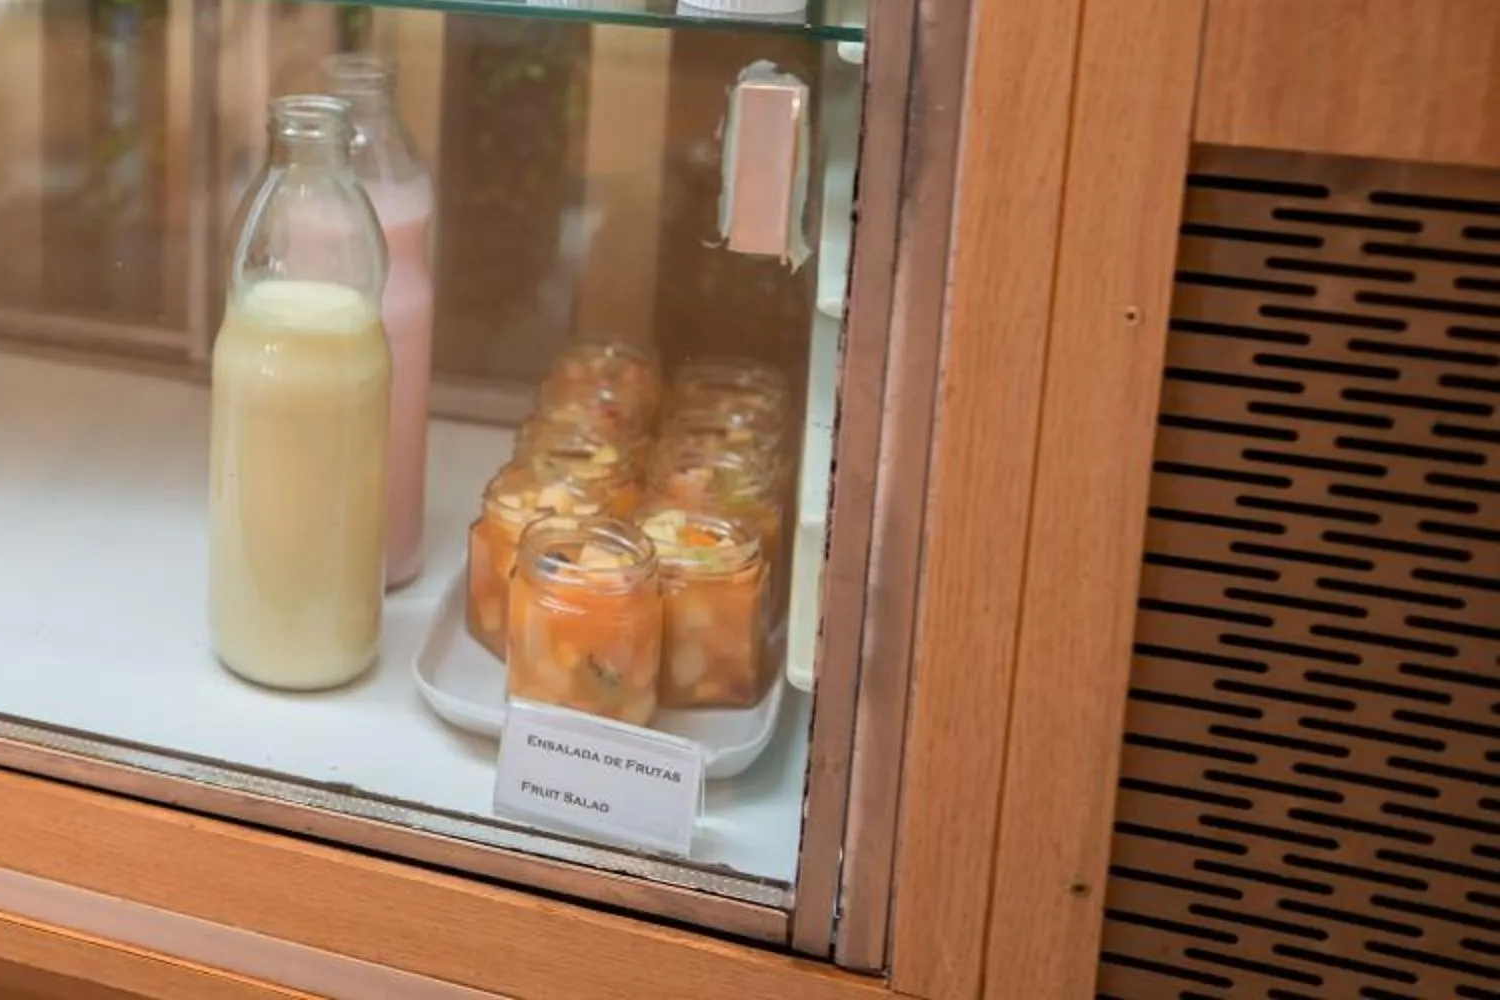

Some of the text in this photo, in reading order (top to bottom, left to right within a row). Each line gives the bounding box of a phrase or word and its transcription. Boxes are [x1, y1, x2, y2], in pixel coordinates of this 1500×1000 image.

[526, 734, 681, 783] ENSALADA DE FRUTAS
[521, 780, 610, 814] FRUIT SALAD
